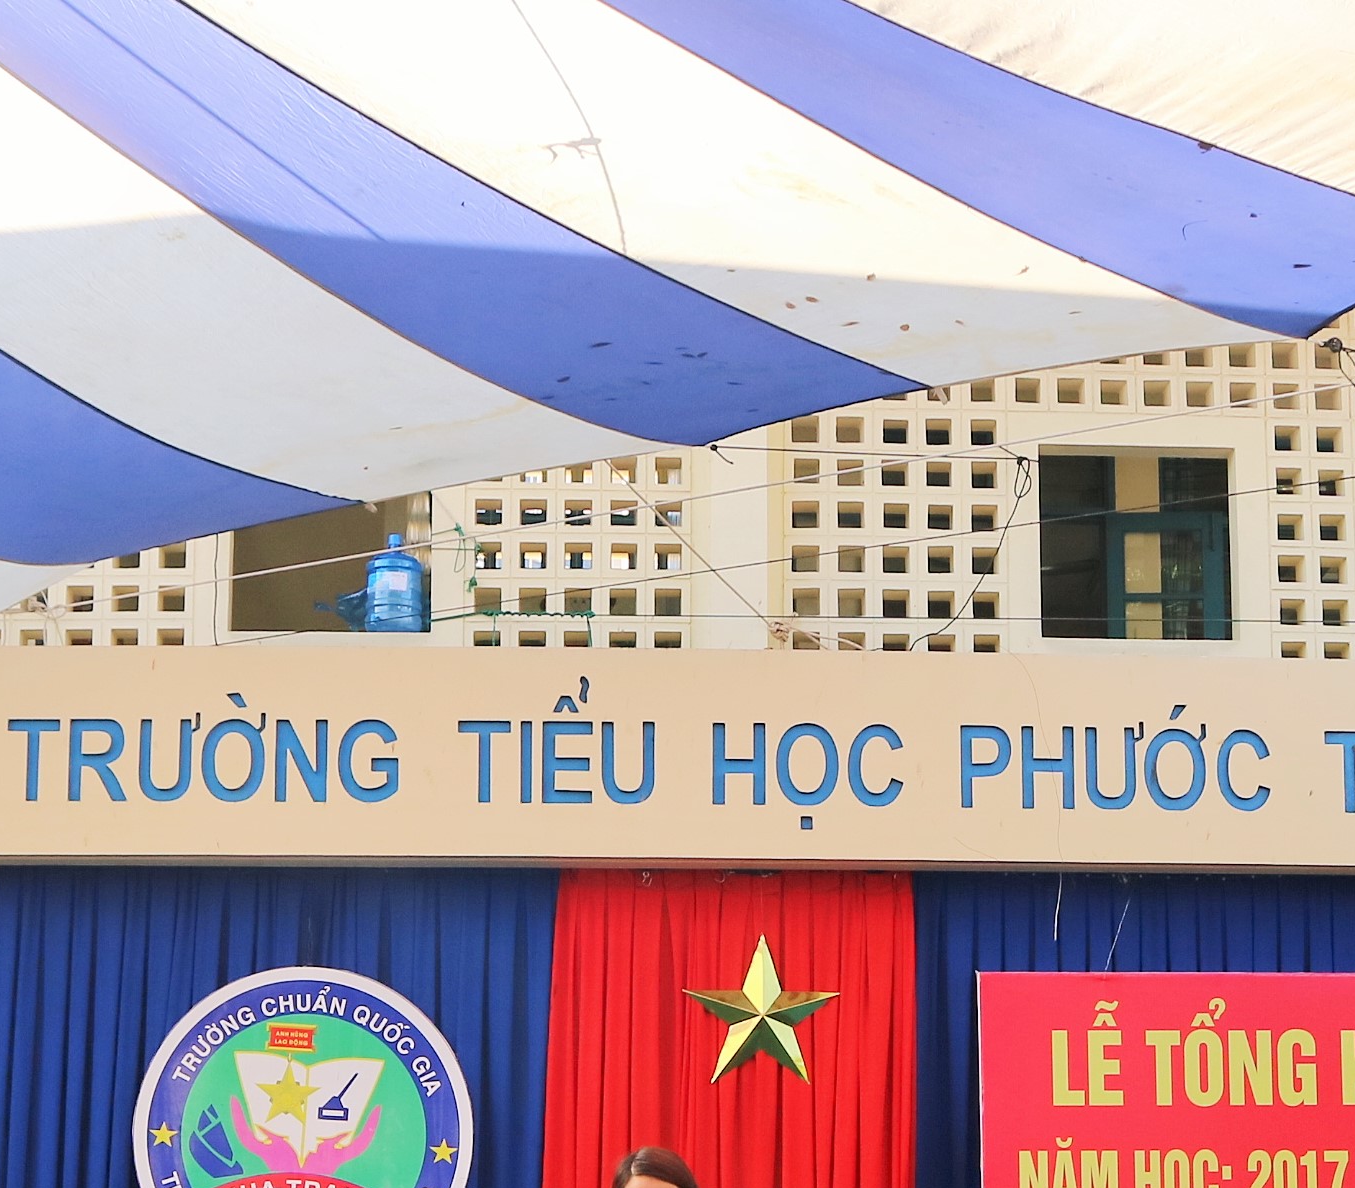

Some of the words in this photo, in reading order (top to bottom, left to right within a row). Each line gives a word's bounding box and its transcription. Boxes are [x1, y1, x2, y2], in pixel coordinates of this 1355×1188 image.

[10, 692, 398, 802] TRƯỜNG
[461, 678, 654, 804] TIỂU
[713, 722, 901, 828] HỌC
[962, 708, 1268, 811] PHƯỚC
[172, 1006, 257, 1082] TRƯỜNG
[260, 986, 347, 1017] CHUẨN
[353, 1005, 415, 1055] QUỐC
[411, 1056, 442, 1098] GIA
[1051, 1000, 1124, 1106] LỄ
[1146, 997, 1318, 1106] TỔNG
